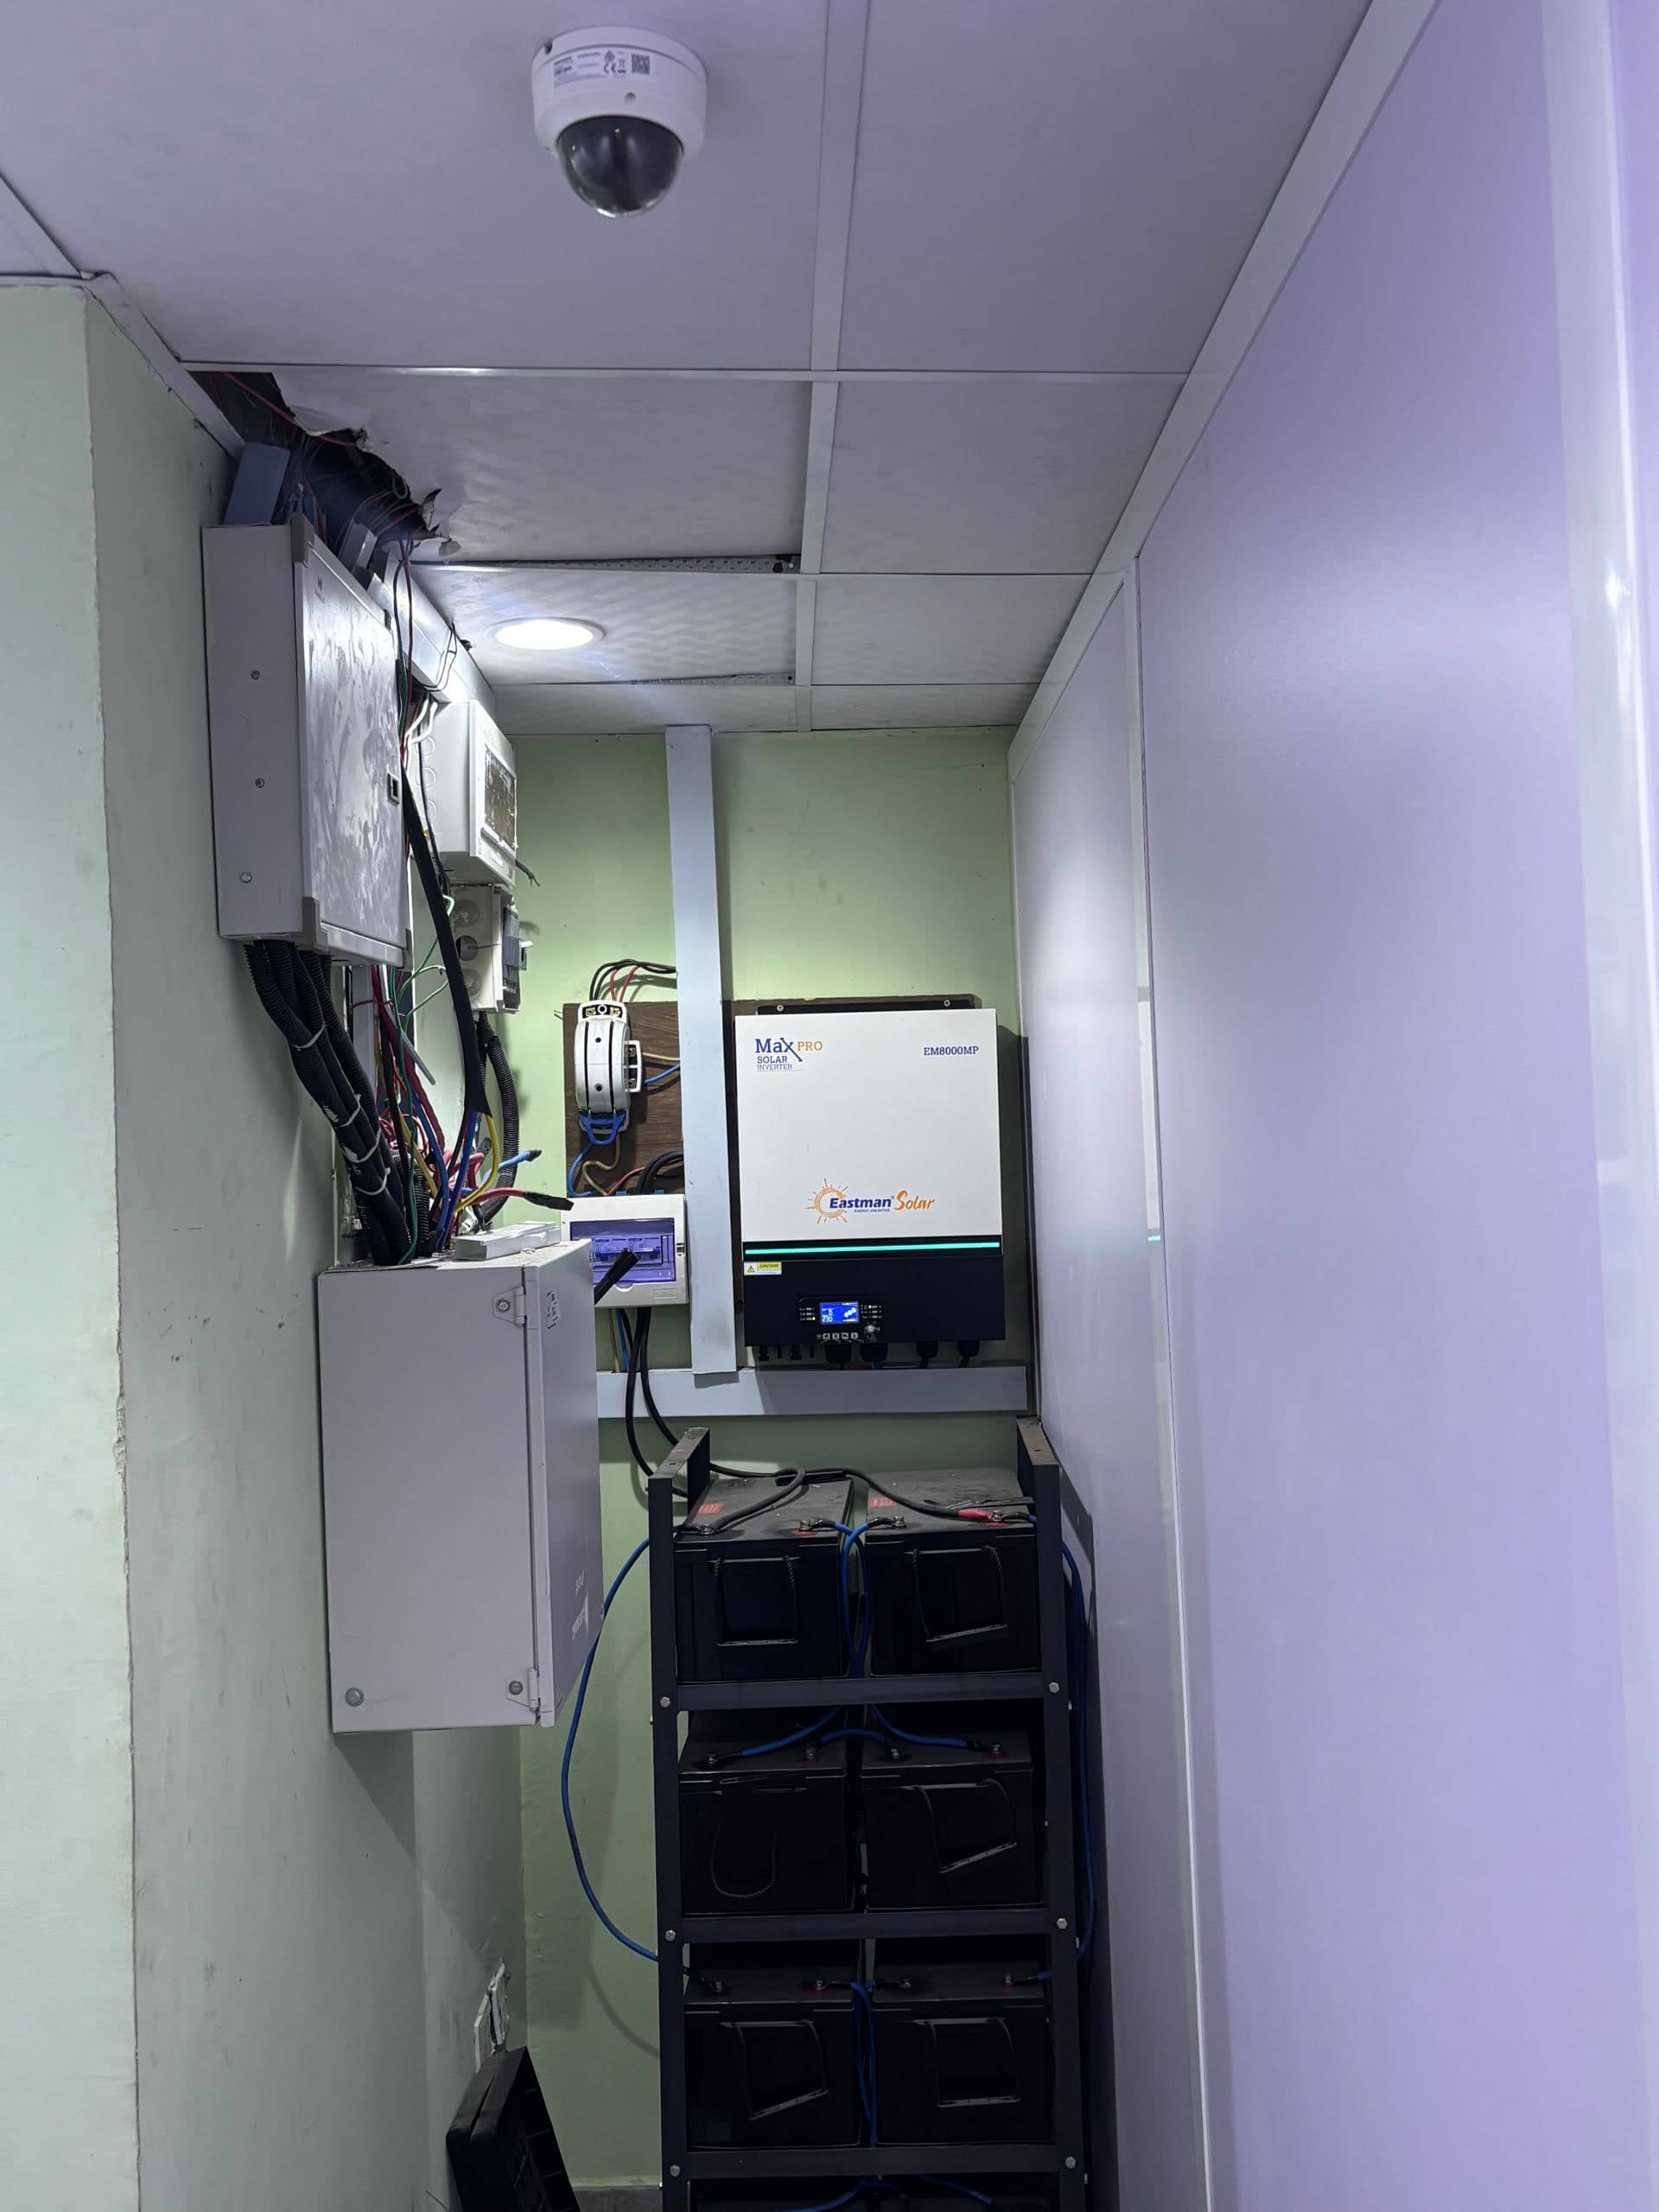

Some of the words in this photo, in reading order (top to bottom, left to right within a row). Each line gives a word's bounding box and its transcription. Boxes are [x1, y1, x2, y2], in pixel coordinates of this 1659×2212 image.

[798, 1041, 823, 1052] PRO
[924, 1046, 979, 1056] EM8000MP
[830, 1198, 892, 1209] Eastman
[893, 1190, 935, 1211] Solar
